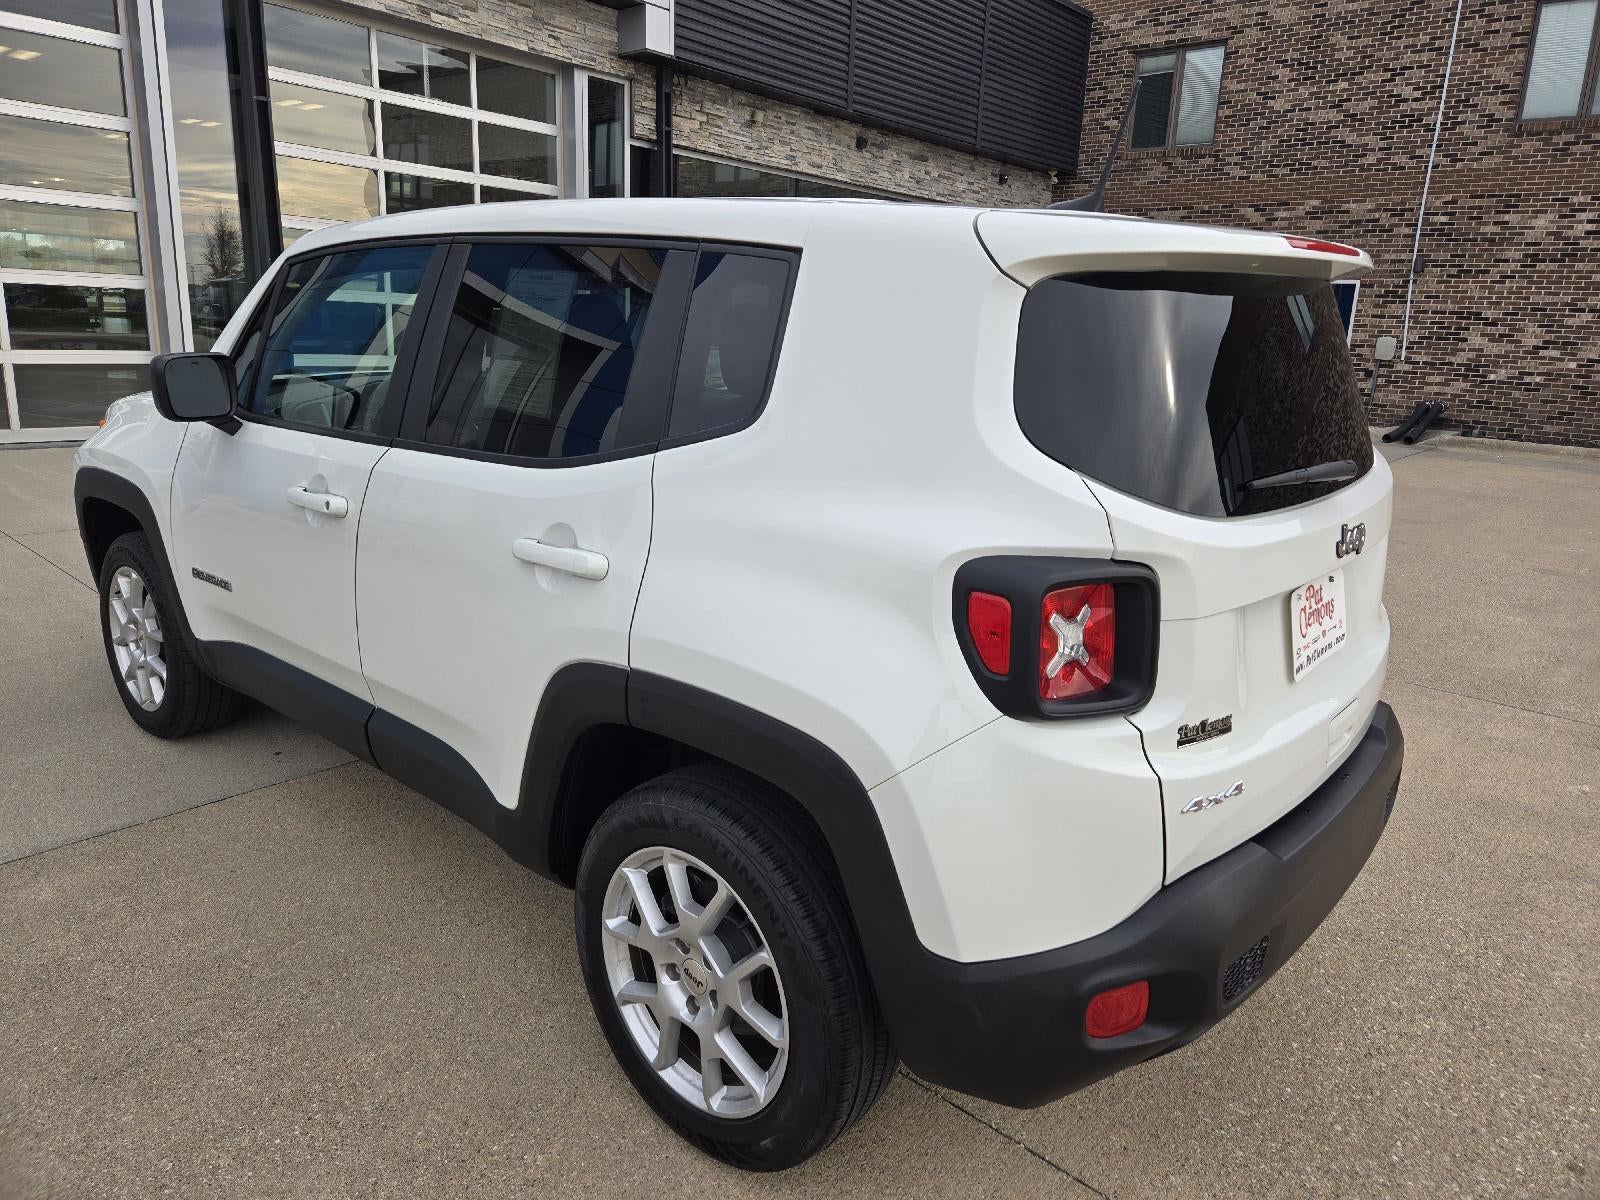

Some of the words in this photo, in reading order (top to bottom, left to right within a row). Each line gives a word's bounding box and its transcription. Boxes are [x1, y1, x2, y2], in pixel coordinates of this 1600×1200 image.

[1336, 523, 1366, 558] Jeep
[1305, 584, 1323, 609] Pat
[1300, 598, 1335, 639] Clemons
[684, 967, 704, 988] Jeep
